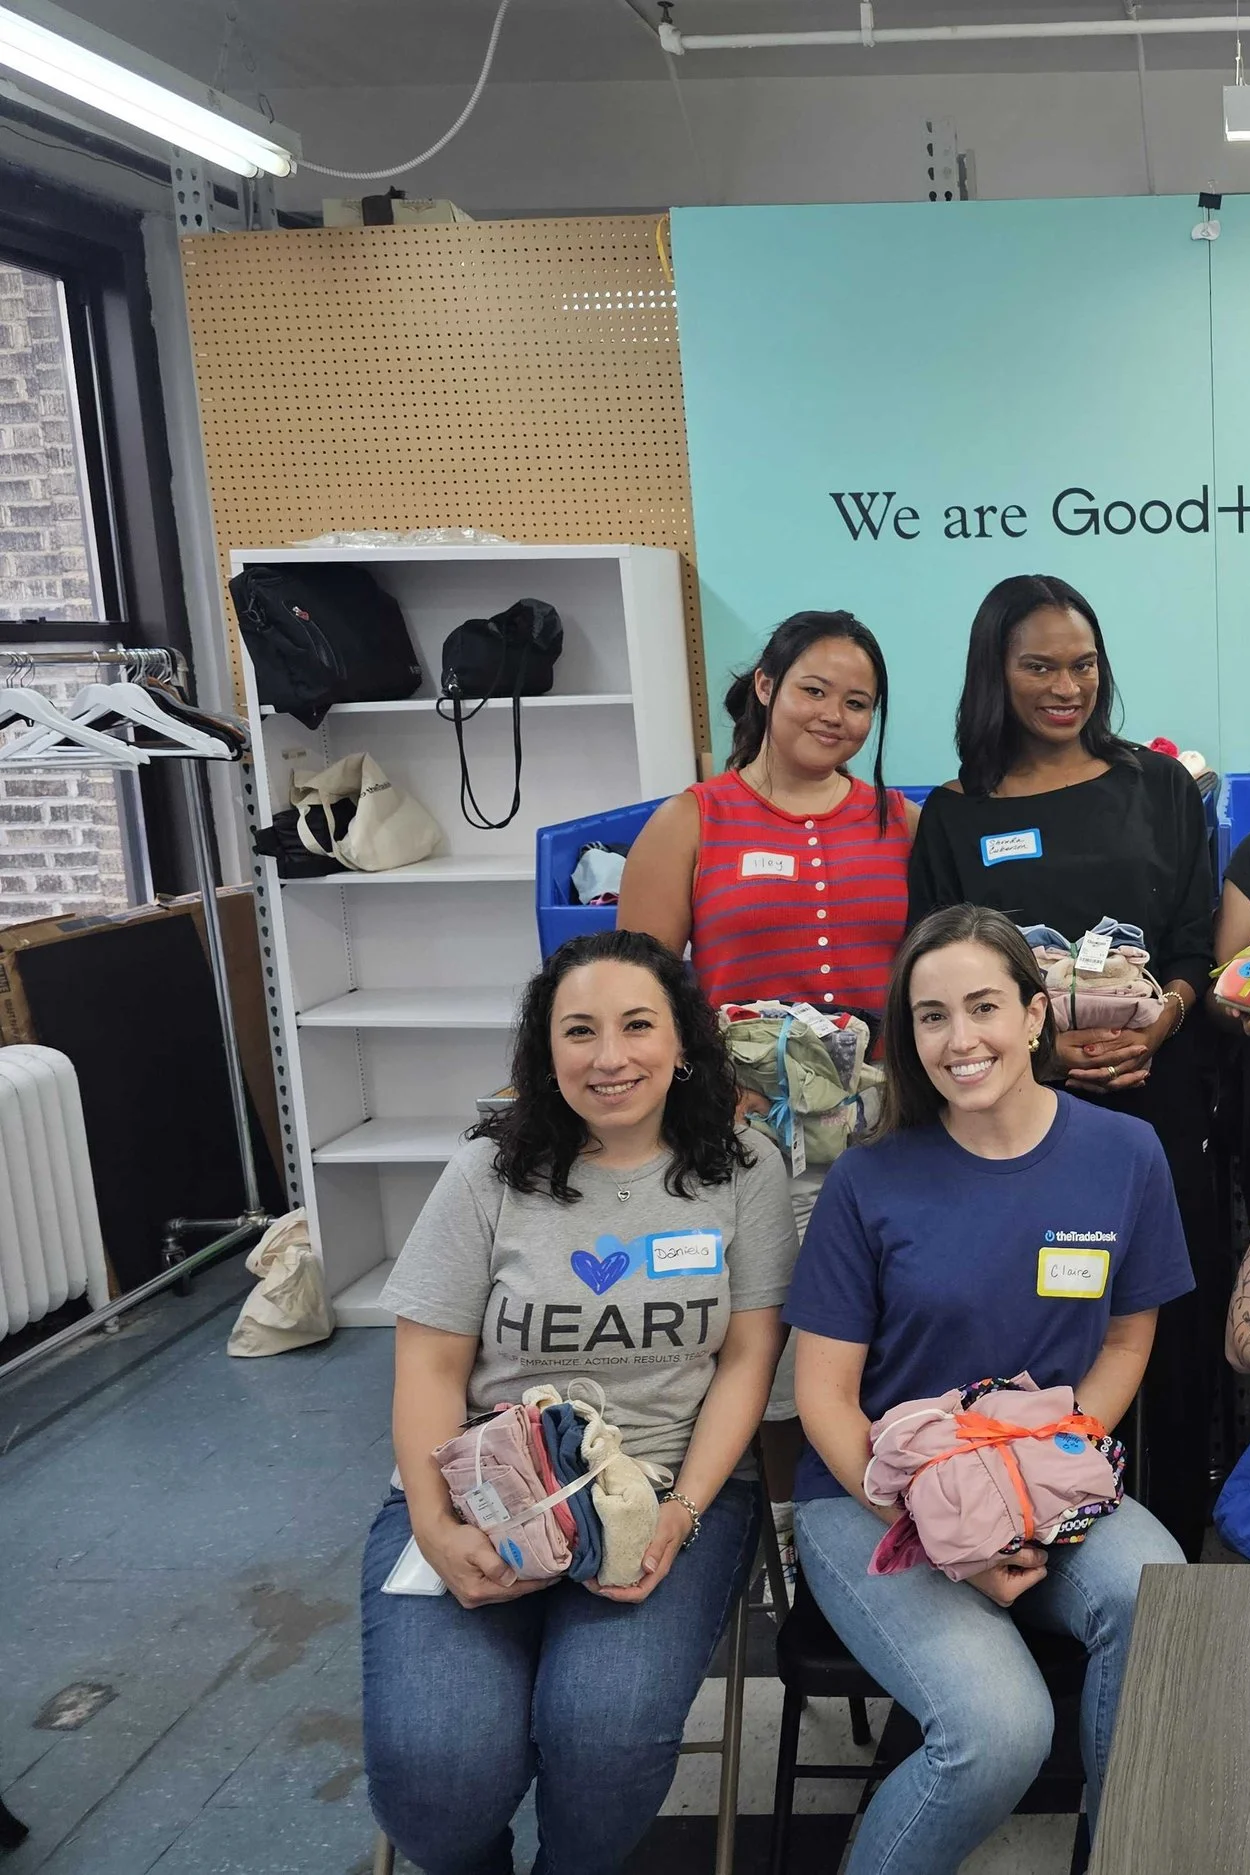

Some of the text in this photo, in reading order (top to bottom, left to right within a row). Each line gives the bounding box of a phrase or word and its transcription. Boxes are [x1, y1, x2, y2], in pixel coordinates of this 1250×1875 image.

[829, 491, 920, 541] We
[943, 499, 1028, 540] are
[1055, 1230, 1118, 1242] theTradeDesk
[654, 1245, 710, 1260] Daniela
[1051, 1264, 1091, 1278] Claire
[496, 1296, 719, 1353] HEART
[584, 1357, 631, 1366] ACTION.
[634, 1354, 681, 1363] RESULTS.
